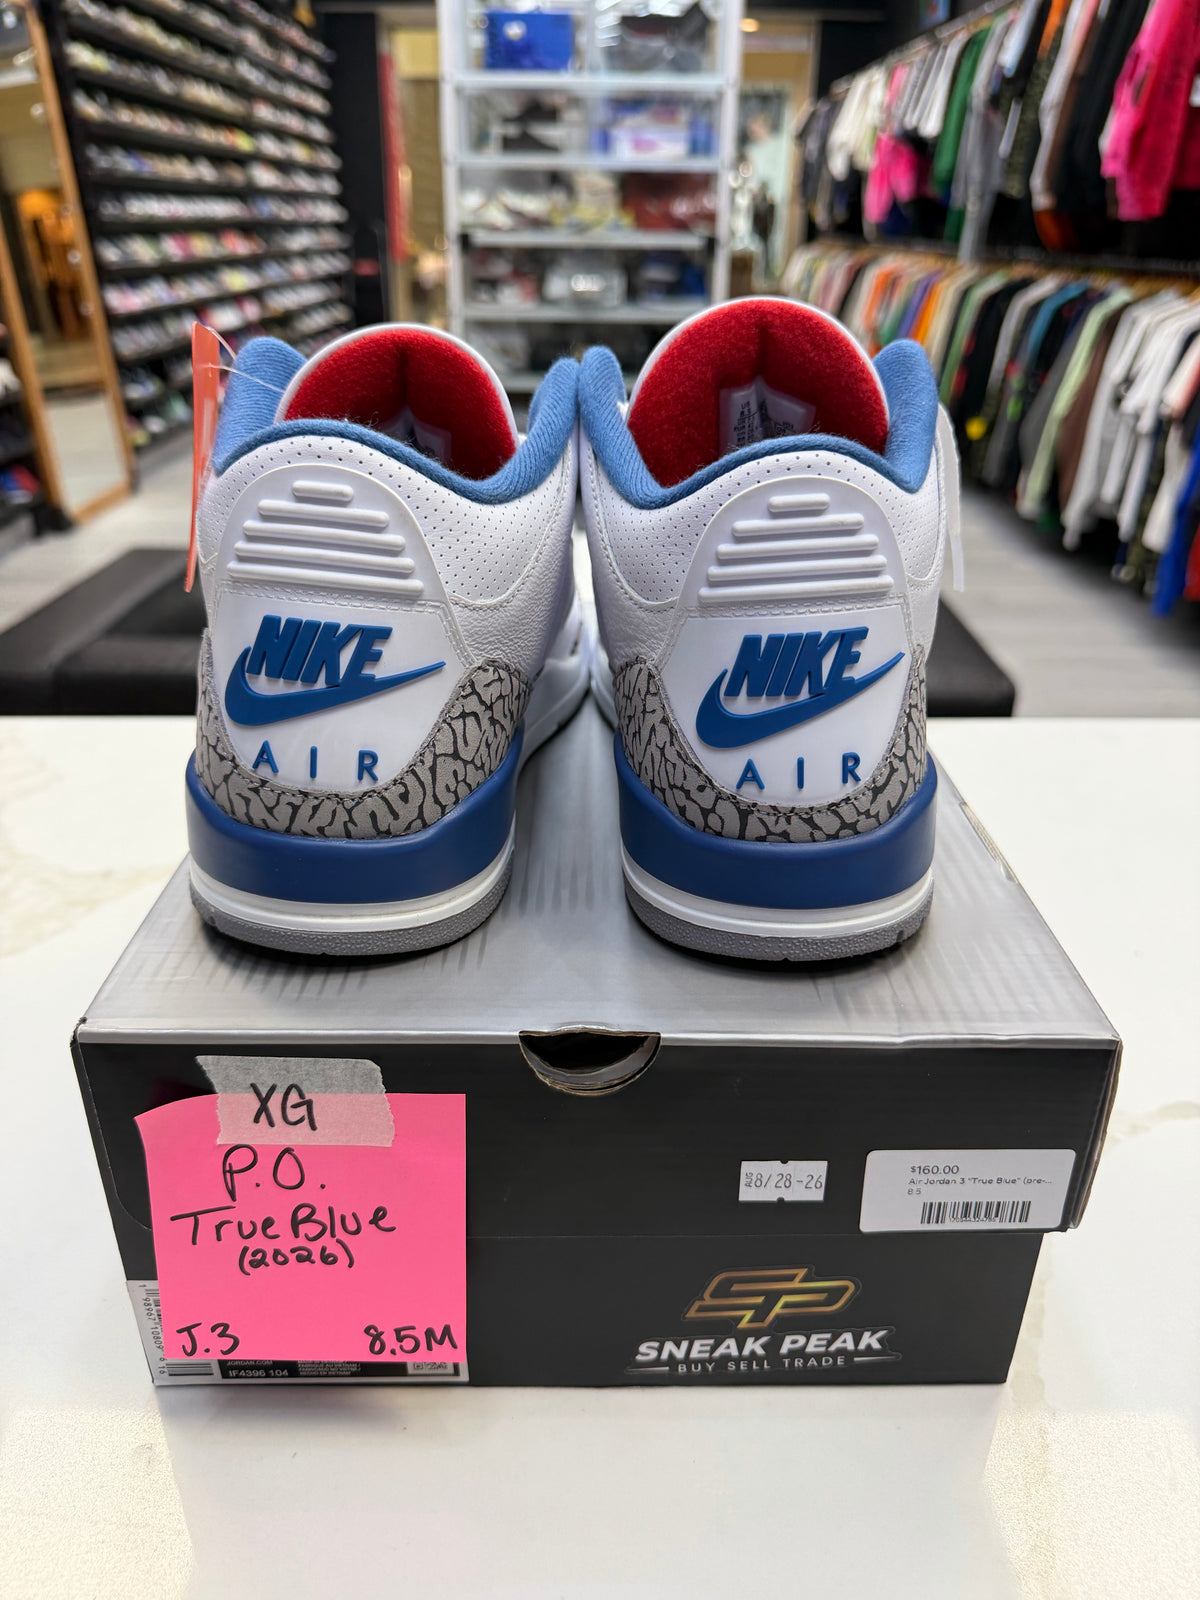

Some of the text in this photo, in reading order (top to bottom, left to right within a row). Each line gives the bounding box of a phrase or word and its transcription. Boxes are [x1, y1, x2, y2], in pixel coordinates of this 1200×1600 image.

[246, 614, 393, 687] NIKE
[723, 626, 869, 697] NIKE
[252, 740, 379, 782] AIR
[736, 752, 861, 790] AIR
[250, 1083, 317, 1131] XG
[222, 1144, 326, 1202] P.O.
[910, 1165, 960, 1175] $160.00
[968, 1177, 994, 1185] "True
[290, 1203, 397, 1242] Blue
[238, 1239, 354, 1275] (2026)
[176, 1322, 458, 1357] J.3 8.5M
[635, 1329, 889, 1363] SNEAK PEAK
[269, 1369, 289, 1377] 104
[678, 1355, 846, 1374] BUY SELL TRADE
